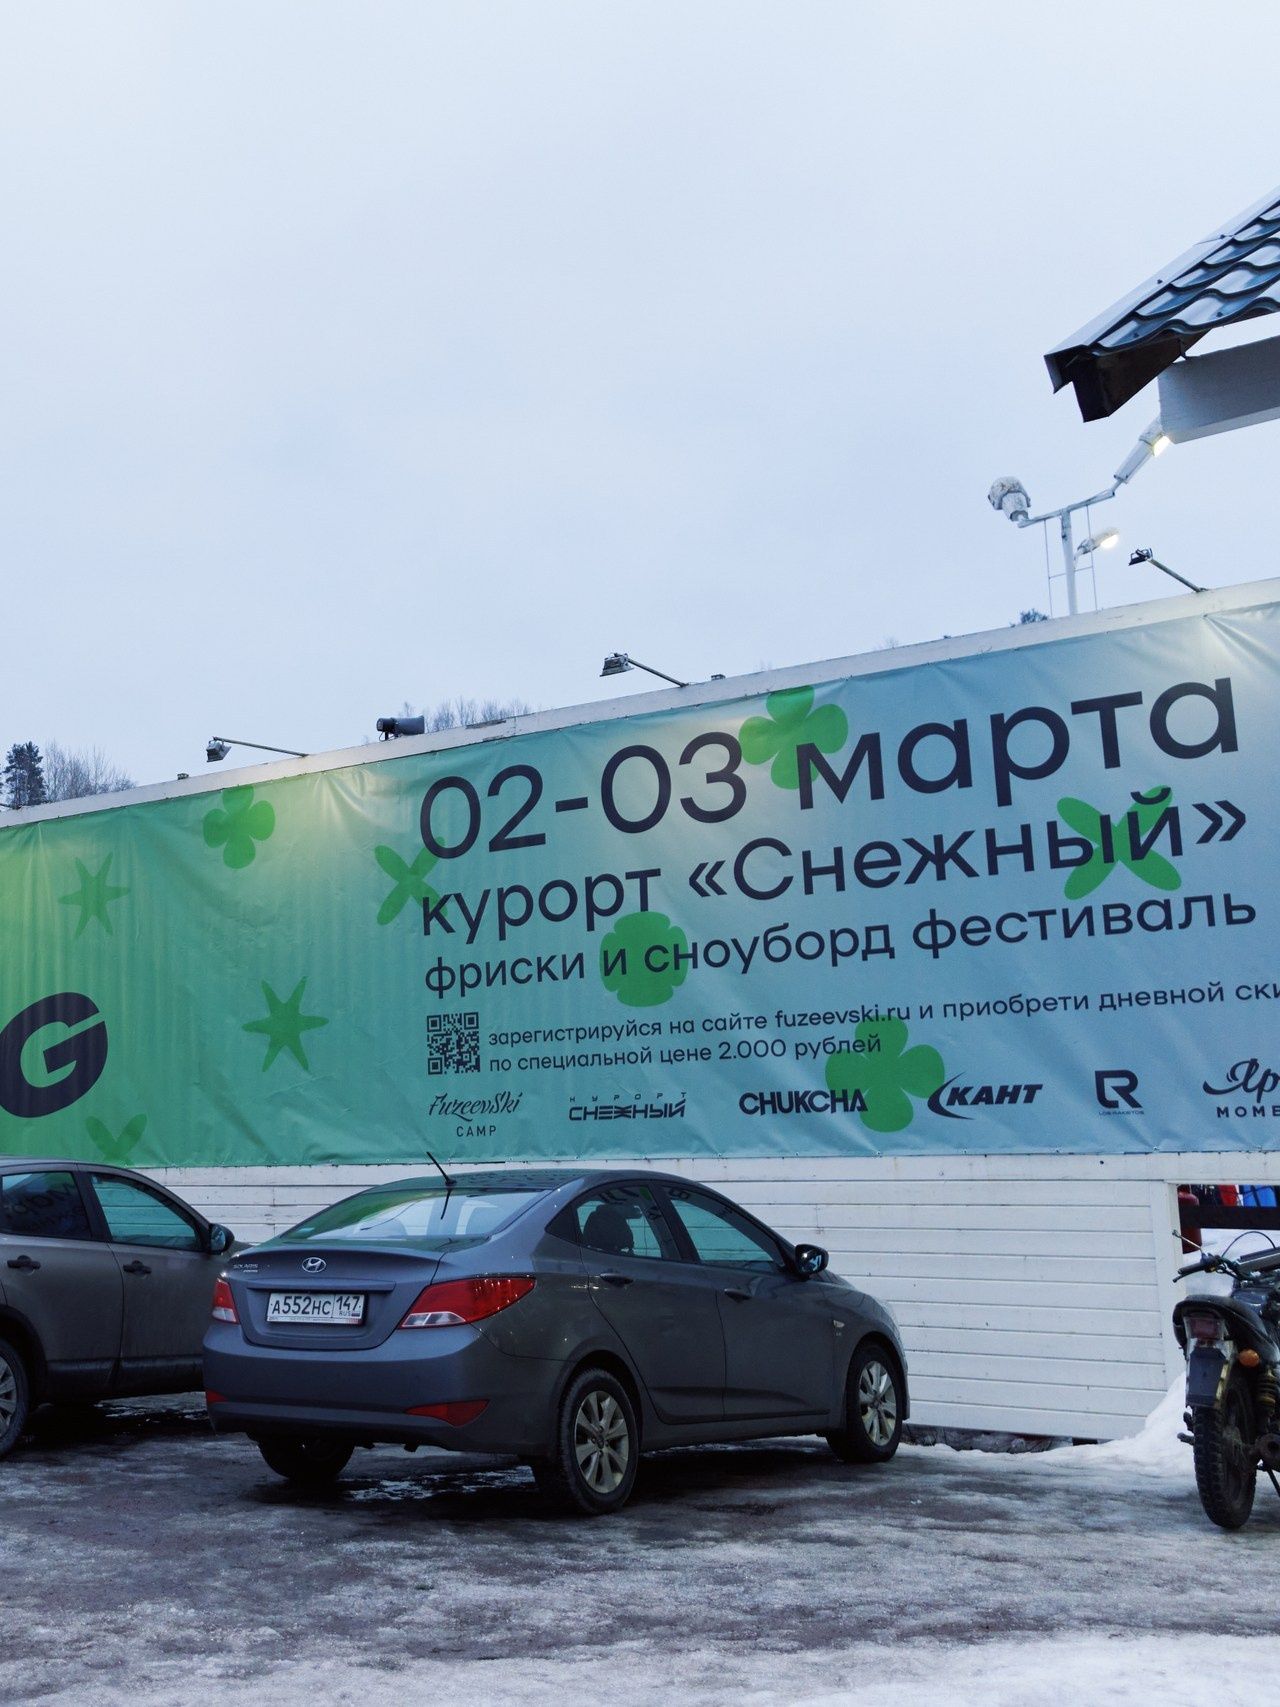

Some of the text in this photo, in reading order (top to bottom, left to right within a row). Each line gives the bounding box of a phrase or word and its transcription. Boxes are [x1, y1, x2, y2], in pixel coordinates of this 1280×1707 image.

[420, 676, 1239, 860] 02-03 марта
[422, 786, 1247, 945] курорт «Снежный»
[425, 892, 1257, 1000] фриски и сноуборд фестиваль
[488, 1019, 662, 1047] зарегистрируйся
[669, 1019, 695, 1034] на
[701, 1013, 768, 1032] сайте
[774, 1004, 911, 1029] fuzeevski.ru
[919, 1004, 933, 1019] и
[943, 994, 1089, 1021] приобрети
[1098, 981, 1225, 1012] дневной
[489, 1033, 882, 1072] по специальной цене 2.000 рублей
[568, 1098, 687, 1121] СНЕЖНЫЙ
[738, 1088, 869, 1116] CHUKCHA
[946, 1083, 1044, 1106] КАНТ
[456, 1125, 497, 1137] CAMP
[271, 1295, 360, 1315] А552НС 147
